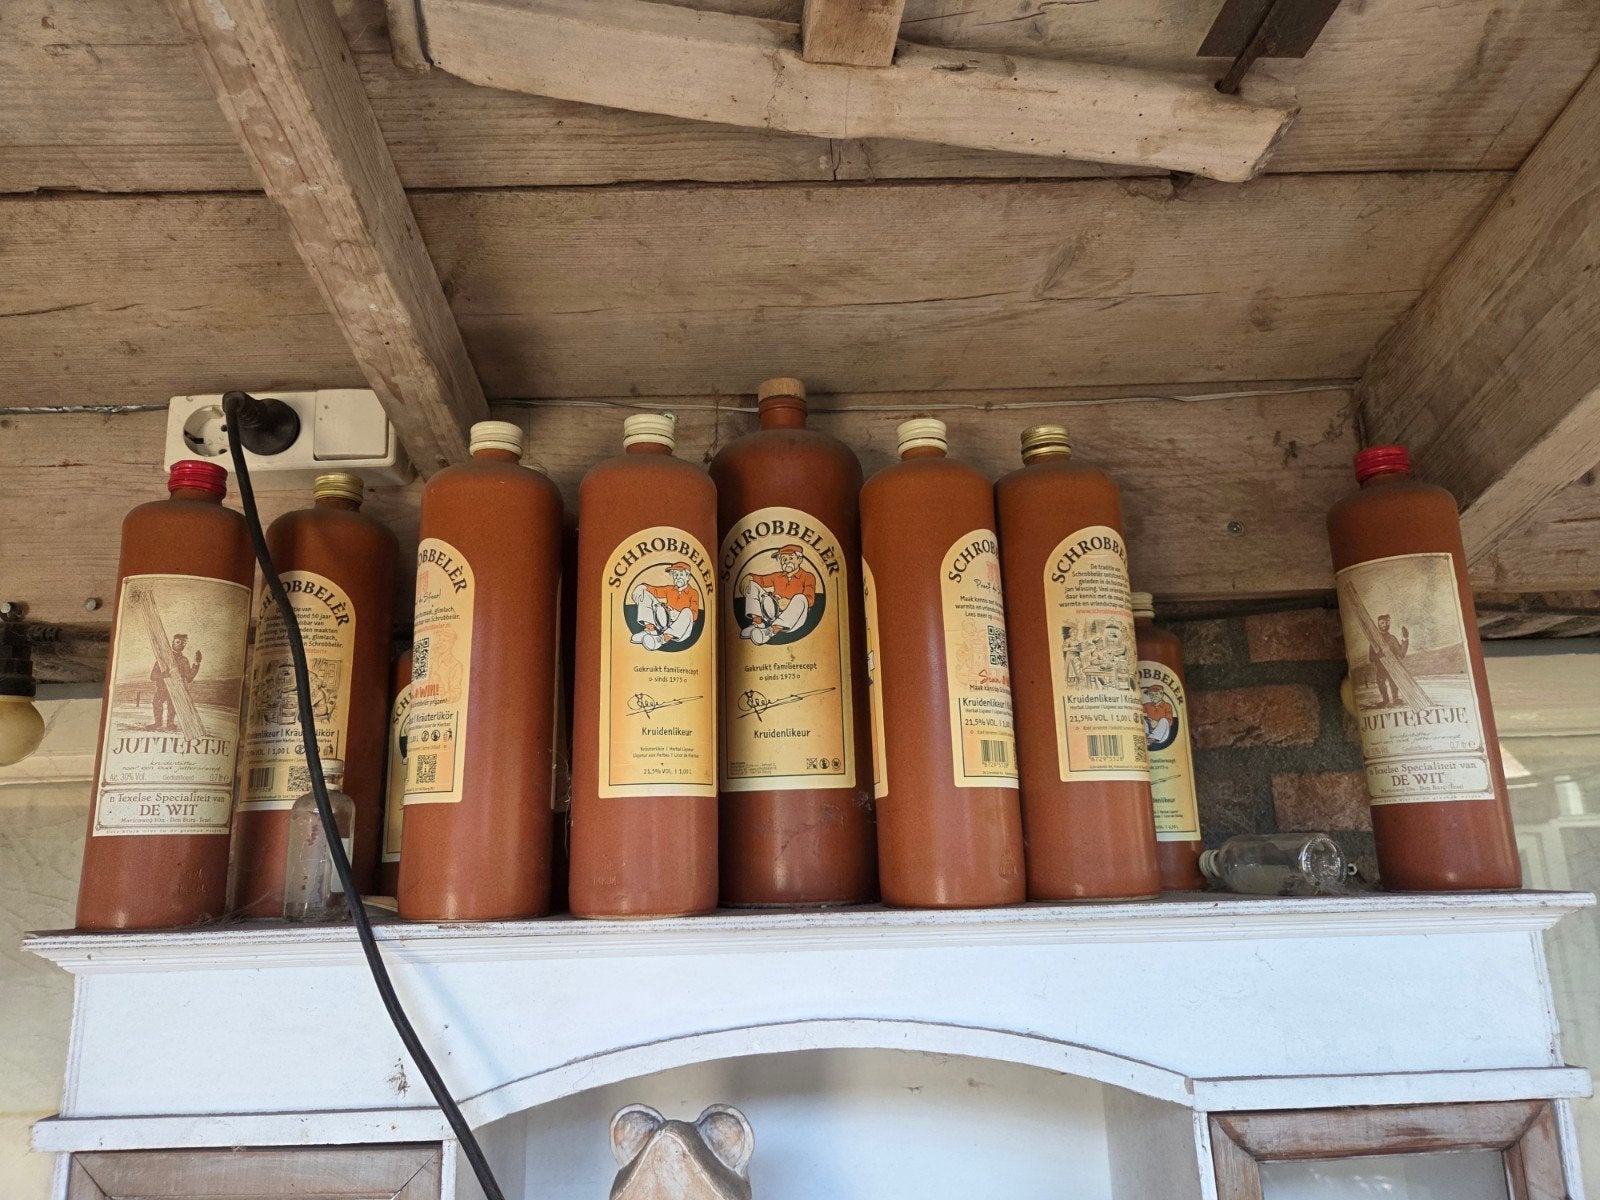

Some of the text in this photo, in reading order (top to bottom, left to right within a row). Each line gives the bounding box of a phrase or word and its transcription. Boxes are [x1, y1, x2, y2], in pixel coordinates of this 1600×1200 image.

[721, 520, 839, 582] SCHROBBELÈR
[744, 662, 818, 673] Gekruikt familierecept
[1067, 694, 1120, 704] Kruidenlikeur
[1069, 714, 1093, 723] 21,5%
[1361, 706, 1469, 733] JUTTERTJE
[641, 726, 693, 737] Kruidenlikeur
[753, 728, 812, 740] Kruidenlikeur
[112, 736, 232, 757] JUTTERTJE
[1401, 761, 1457, 775] Specialiteit
[1391, 771, 1446, 787] DE WIT
[118, 793, 152, 803] Texelse
[155, 792, 210, 804] Specialiteit
[140, 804, 198, 816] DE WIT
